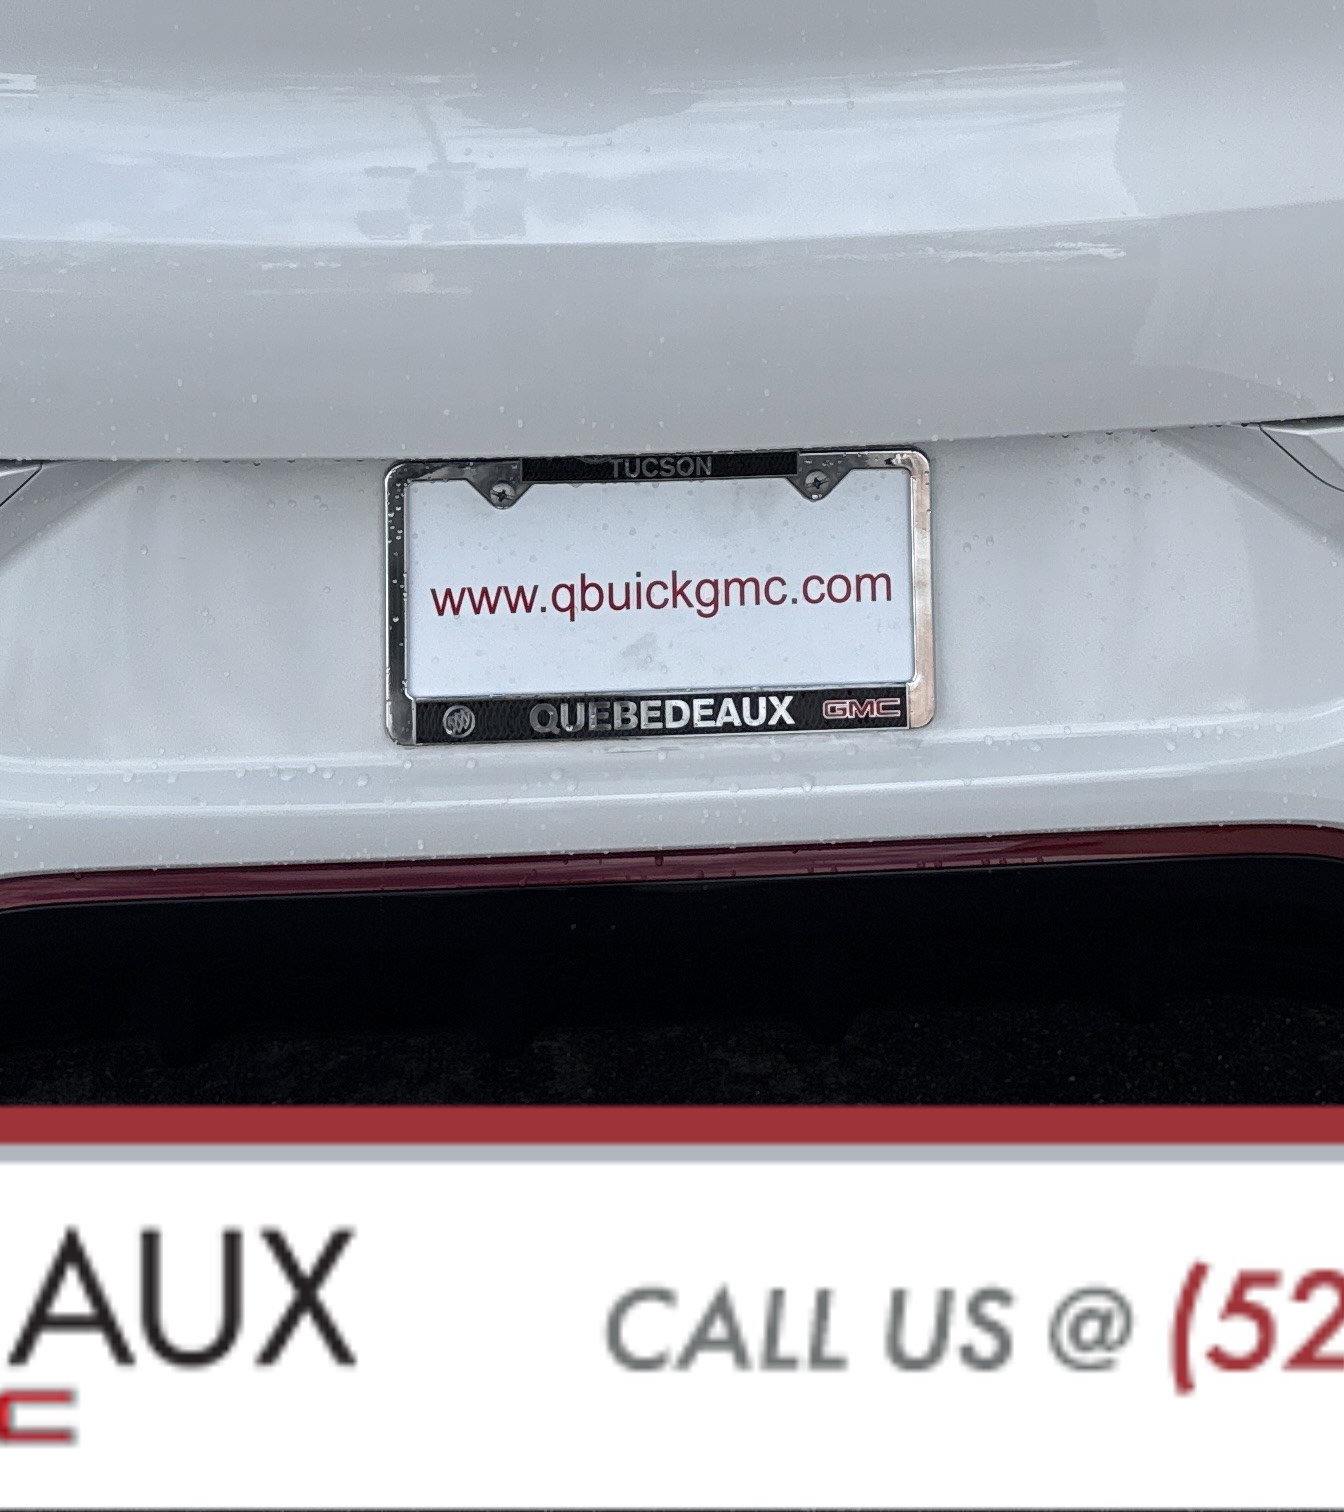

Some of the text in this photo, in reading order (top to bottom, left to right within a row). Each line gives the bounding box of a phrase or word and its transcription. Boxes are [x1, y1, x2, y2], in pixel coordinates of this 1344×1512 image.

[610, 456, 712, 479] TUCSON
[430, 569, 893, 622] www.qbuickgmc.com
[529, 695, 902, 736] QUEBEDEAUX GMC
